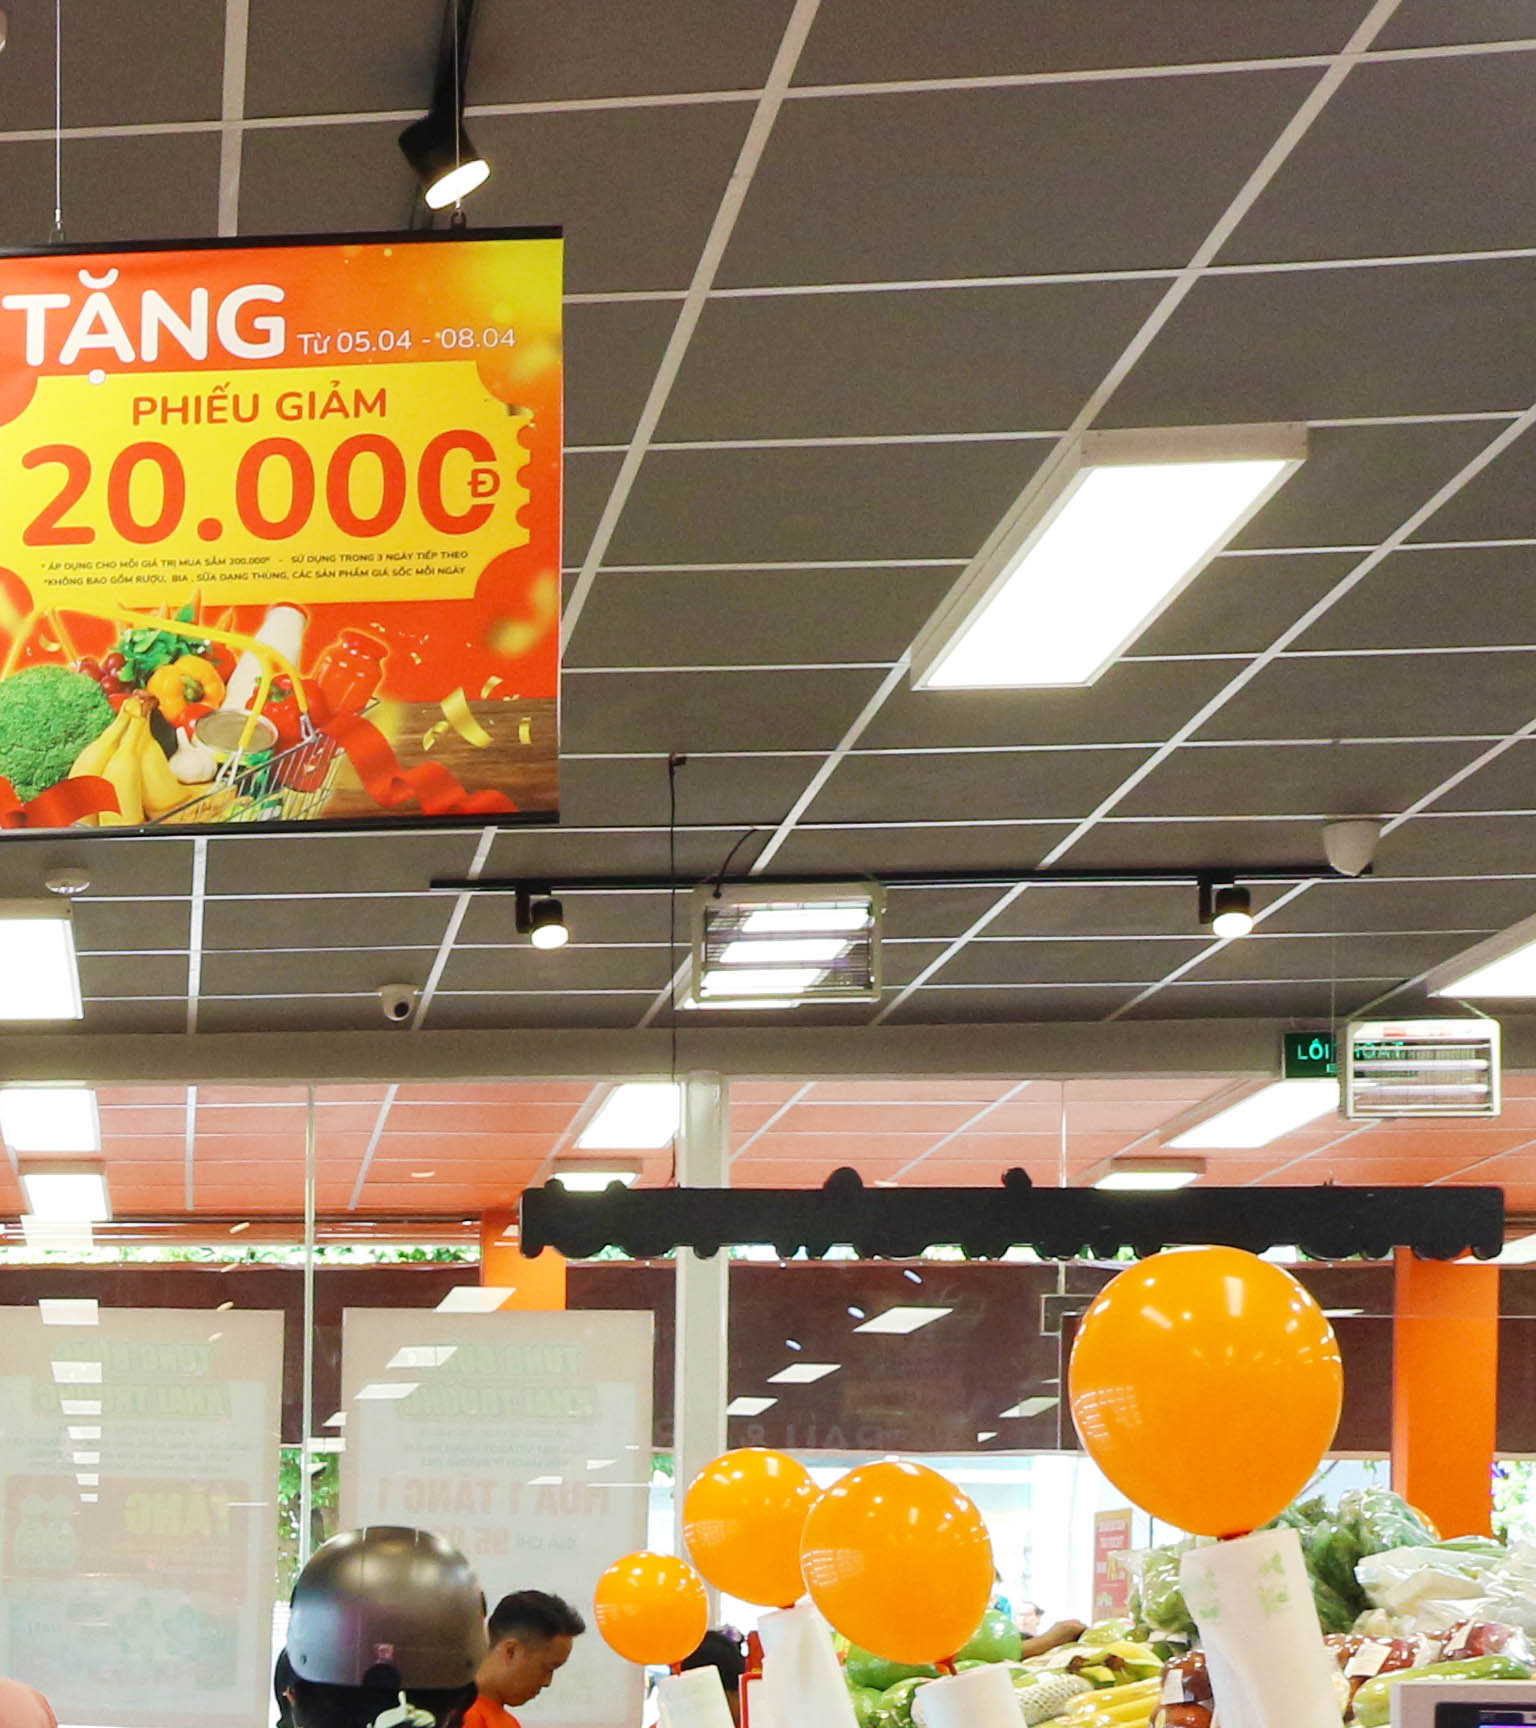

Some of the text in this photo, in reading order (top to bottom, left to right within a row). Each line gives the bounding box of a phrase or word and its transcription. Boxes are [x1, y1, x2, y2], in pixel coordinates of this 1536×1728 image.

[2, 267, 286, 386] TẶNG
[297, 331, 331, 355] Từ
[336, 329, 412, 353] 05.04
[440, 327, 516, 349] 08.04
[132, 379, 387, 427] PHIẾU GIẢM
